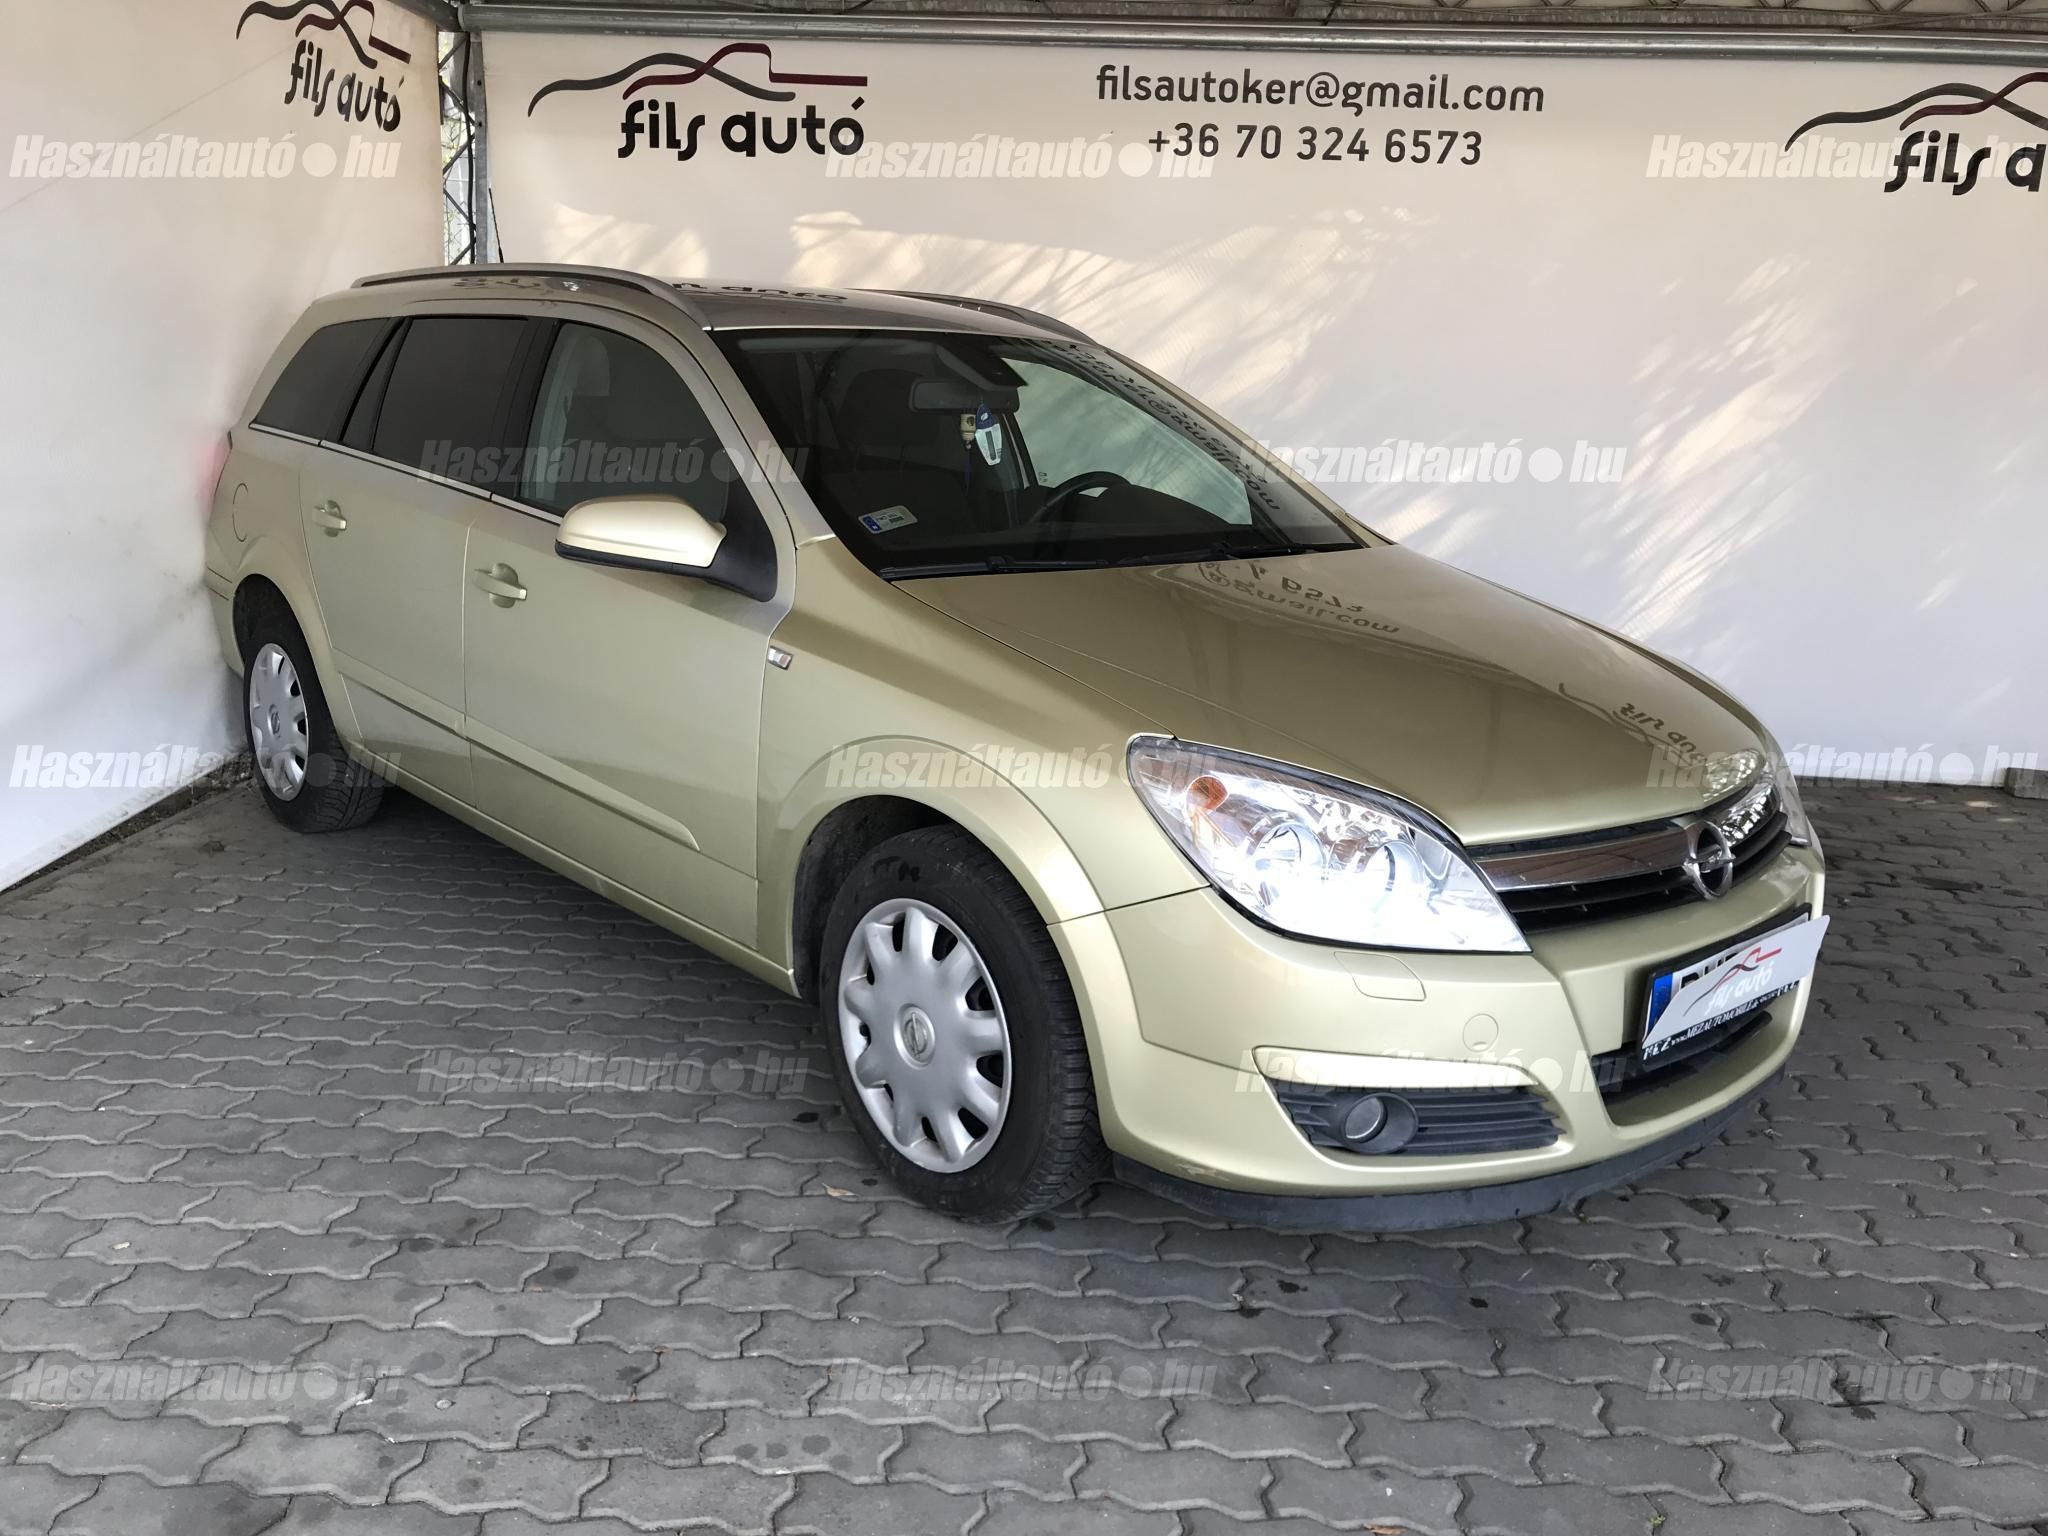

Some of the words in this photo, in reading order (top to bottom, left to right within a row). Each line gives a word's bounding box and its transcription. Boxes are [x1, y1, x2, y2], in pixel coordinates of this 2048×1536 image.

[284, 39, 335, 117] fils
[1096, 64, 1545, 117] filsautoker@gmail.com
[617, 99, 706, 161] fils
[721, 97, 866, 158] autó
[1148, 123, 1219, 159] +36
[1235, 123, 1282, 160] 70
[1296, 126, 1370, 163] 324
[1384, 128, 1482, 166] 6573
[1883, 130, 1991, 196] fils
